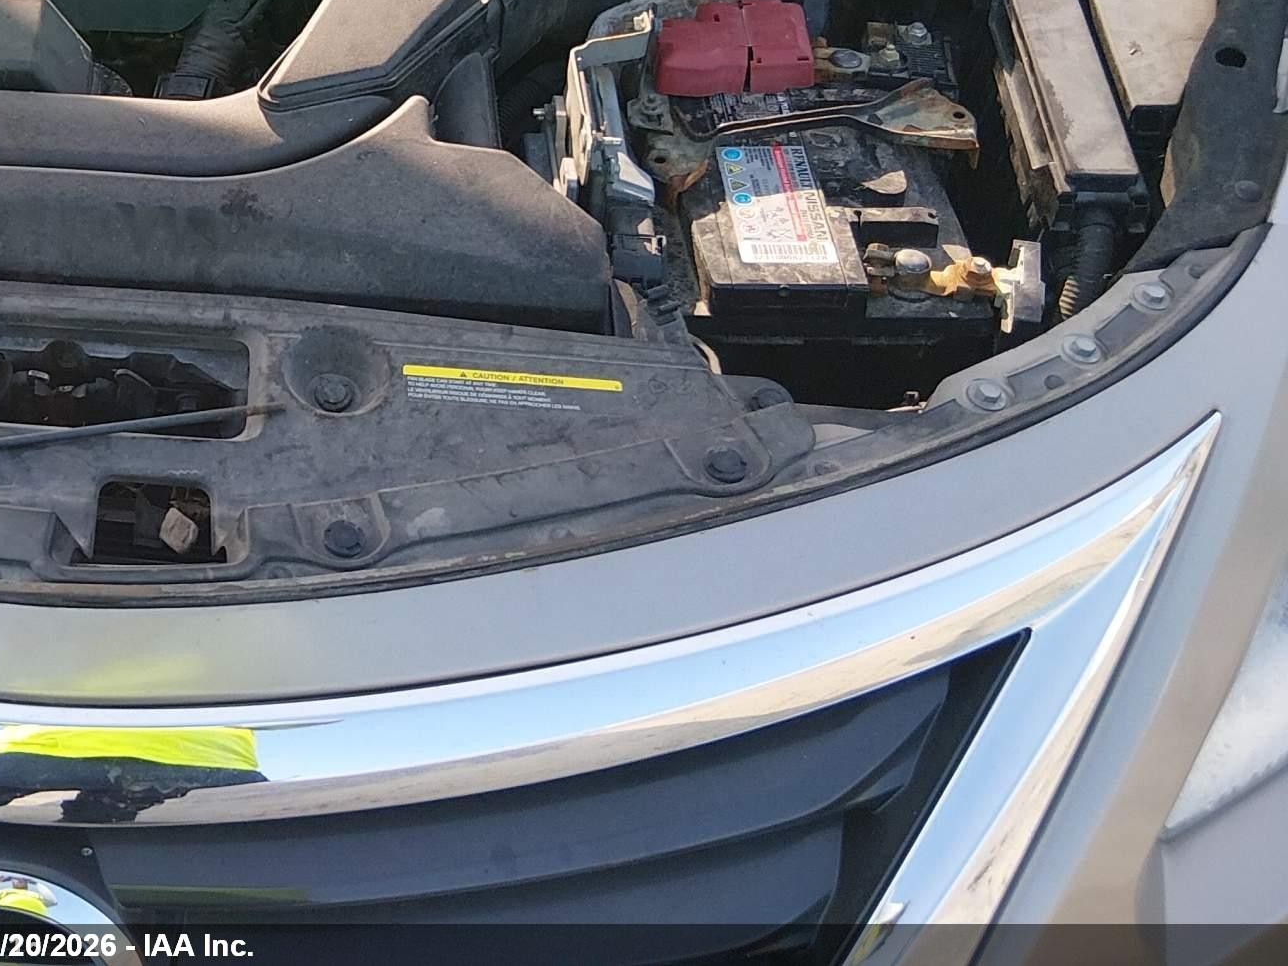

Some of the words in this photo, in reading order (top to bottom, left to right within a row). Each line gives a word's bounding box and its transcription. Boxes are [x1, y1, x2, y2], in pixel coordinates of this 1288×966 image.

[790, 148, 814, 190] RENAULT
[806, 191, 829, 242] NISSAN
[472, 372, 510, 381] CAUTION
[518, 375, 565, 385] ATTENTION
